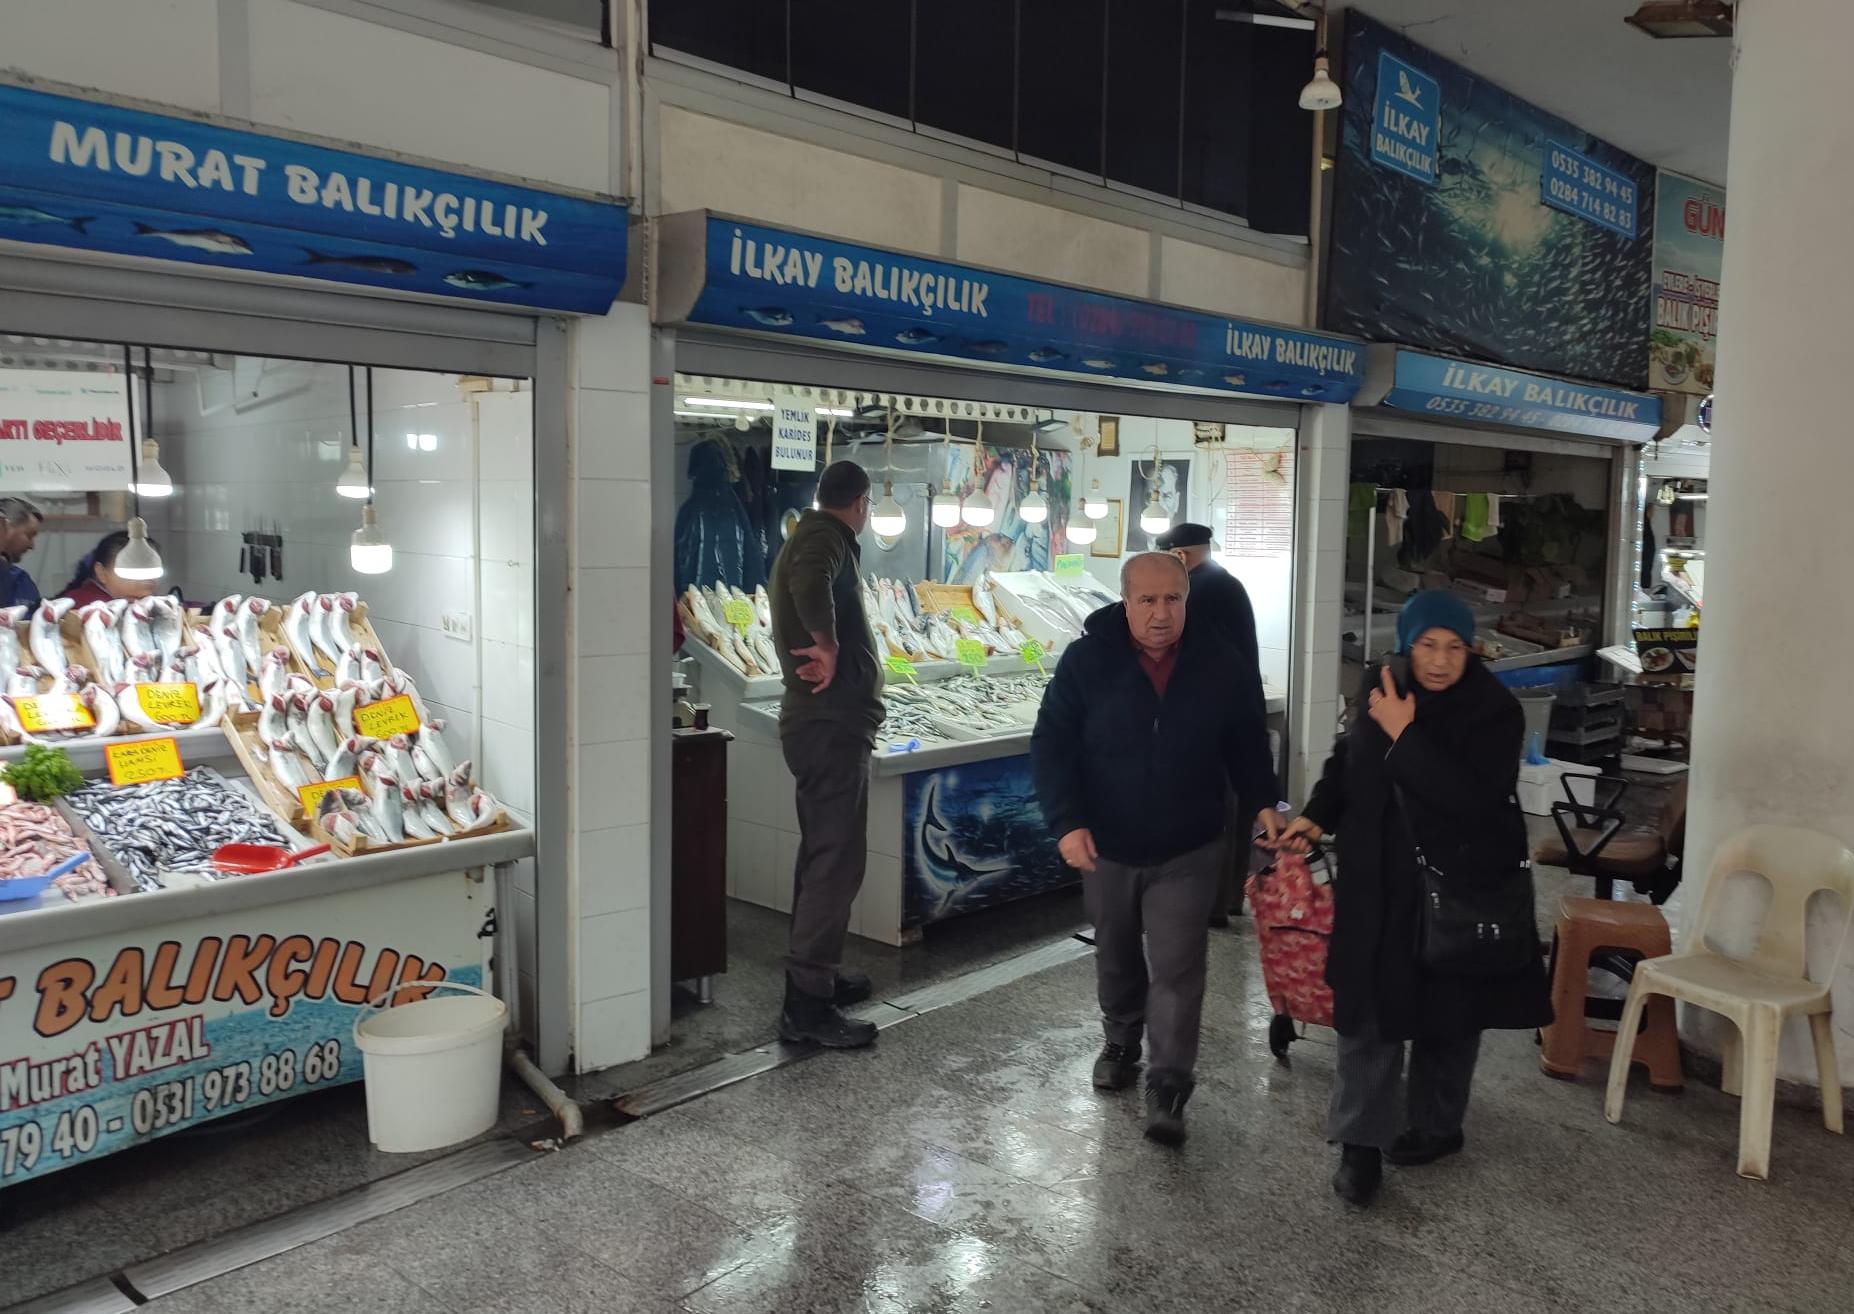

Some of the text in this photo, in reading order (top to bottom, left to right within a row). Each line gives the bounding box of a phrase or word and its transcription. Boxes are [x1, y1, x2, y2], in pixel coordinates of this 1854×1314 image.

[1384, 100, 1430, 146] İLKAY
[1376, 133, 1432, 174] BALIKÇILIK
[1552, 150, 1633, 204] 0535 382 94 45
[49, 121, 549, 246] MURAT BALIKÇILIK
[1551, 177, 1578, 204] 0284
[730, 228, 989, 318] İLKAY BALIKÇILIK
[1226, 322, 1271, 361] İLKAY
[1276, 338, 1356, 376] BALIKÇILIK
[1425, 396, 1467, 413] 0535
[1468, 402, 1496, 418] 382
[1442, 363, 1639, 419] İLKAY BALIKÇILIK
[776, 446, 813, 461] BULUNUR
[33, 933, 446, 1038] BALIKÇILIK
[0, 1014, 211, 1113] Murat YAZAL
[0, 1120, 42, 1177] 79
[52, 1104, 98, 1159] 40
[131, 1075, 195, 1135] 0531
[203, 1060, 252, 1112] 973
[259, 1047, 296, 1096] 88
[304, 1038, 341, 1085] 68
